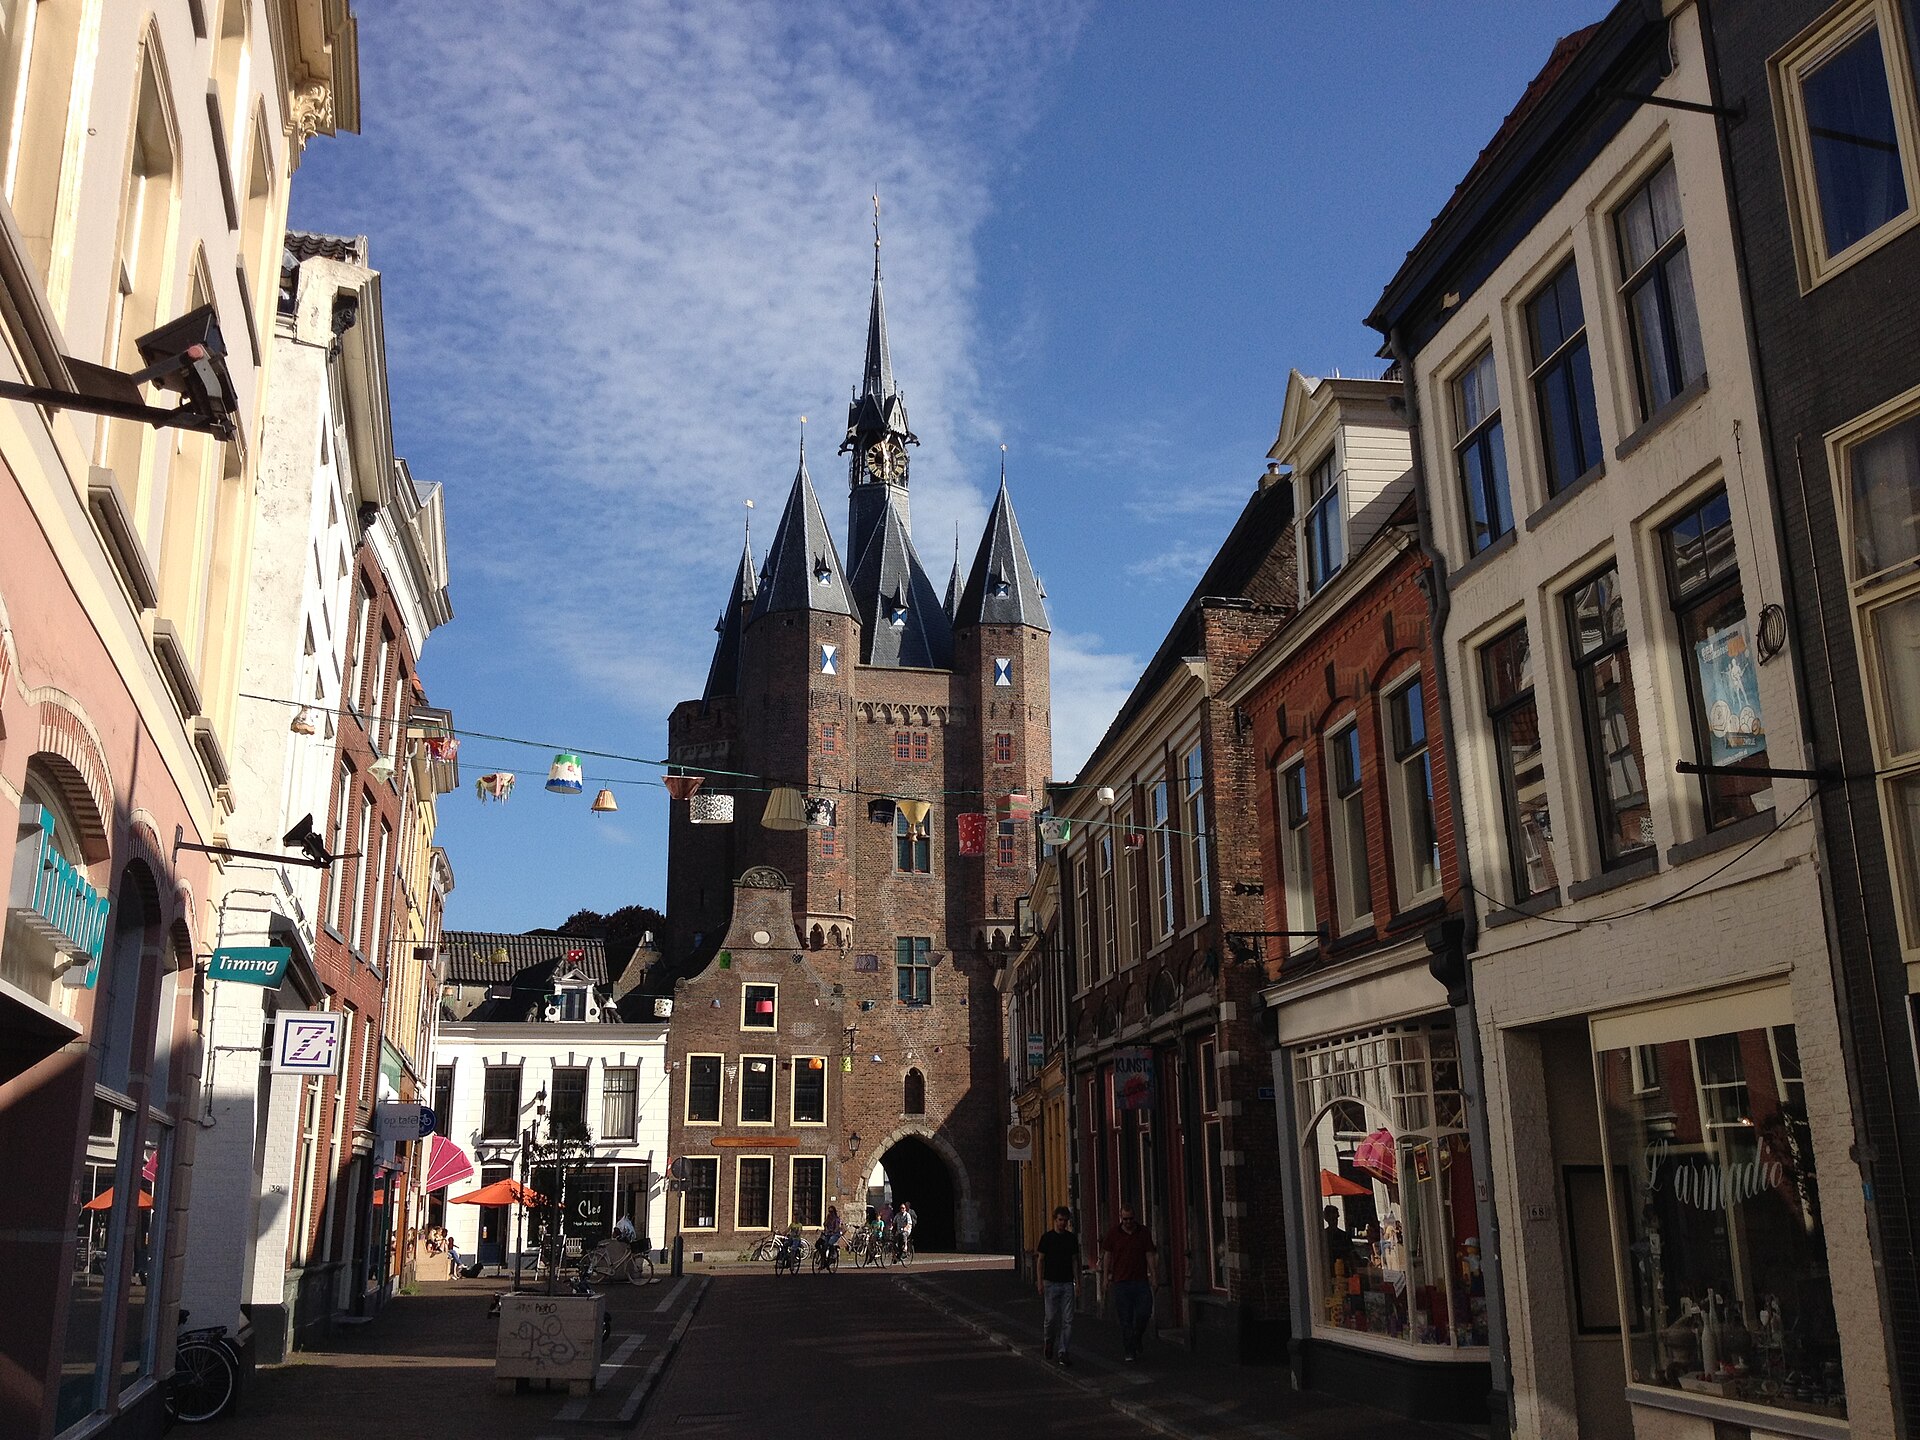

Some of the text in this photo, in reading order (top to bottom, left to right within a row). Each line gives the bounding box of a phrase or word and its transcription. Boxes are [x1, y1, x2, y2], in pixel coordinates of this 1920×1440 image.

[219, 955, 278, 975] Timing
[1116, 1058, 1149, 1073] KUNST
[398, 1115, 418, 1125] tafel
[1531, 1207, 1545, 1217] 68
